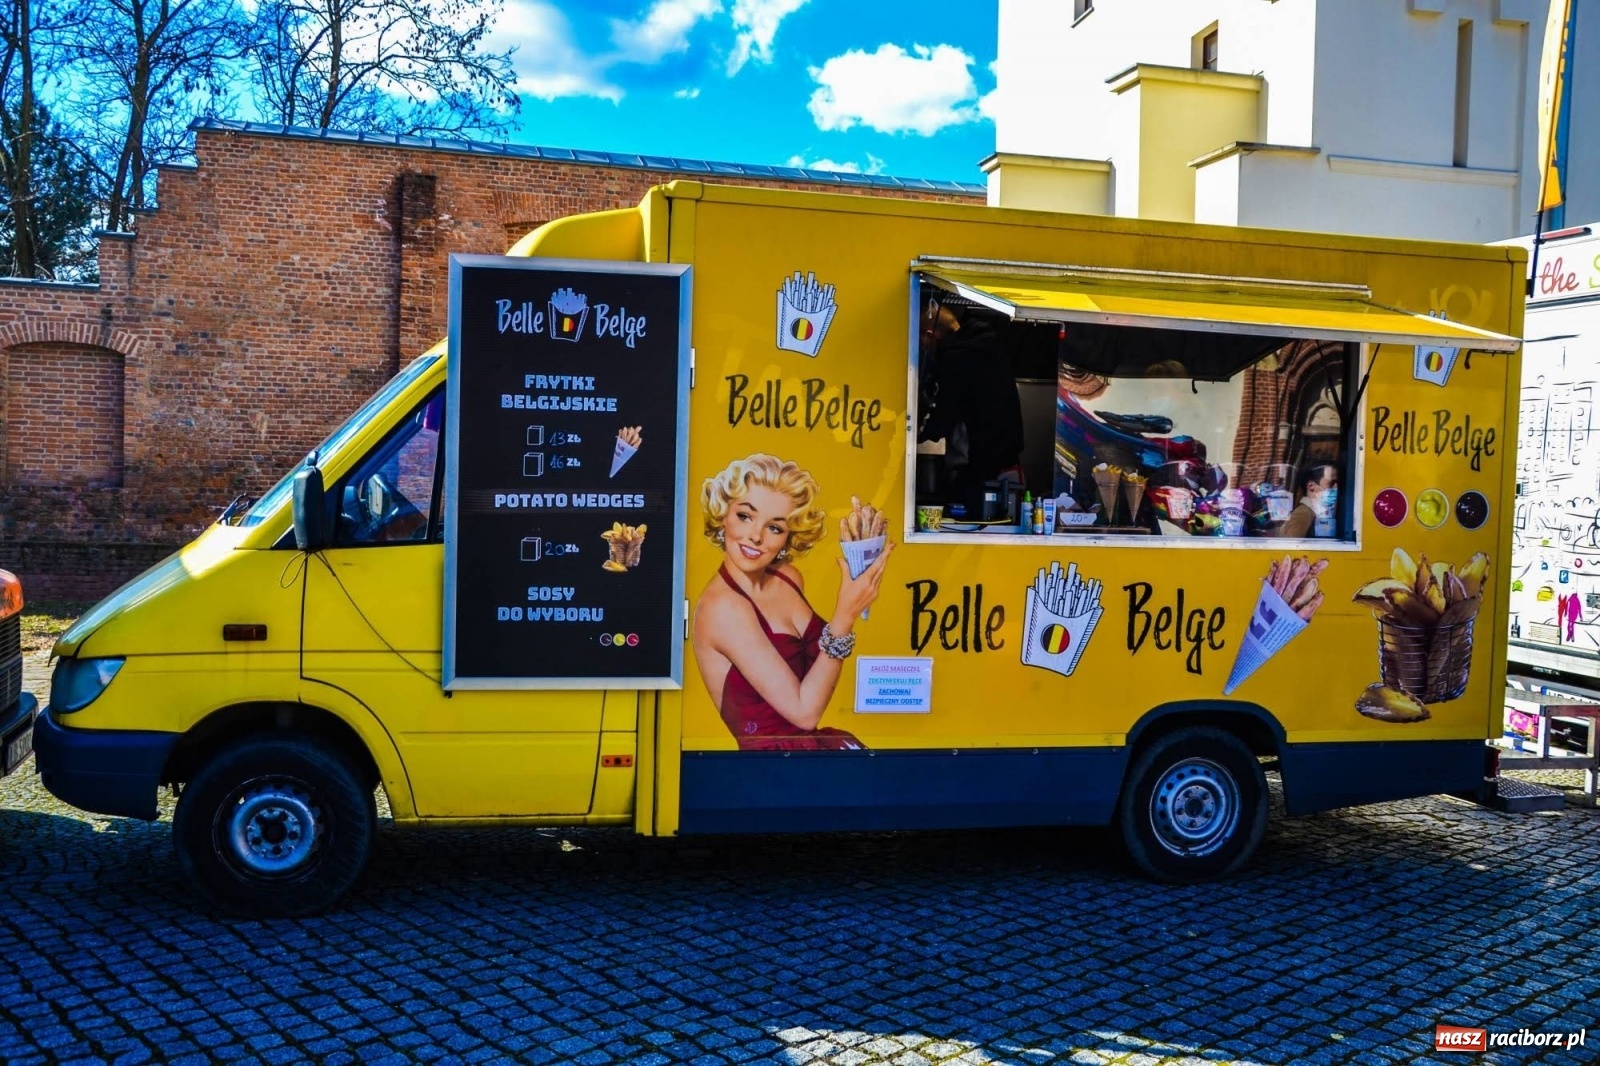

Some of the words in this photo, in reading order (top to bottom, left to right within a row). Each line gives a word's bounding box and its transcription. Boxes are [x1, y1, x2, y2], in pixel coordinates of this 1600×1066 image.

[1539, 256, 1580, 294] the
[496, 299, 544, 335] Belle
[593, 303, 647, 349] Belge
[525, 374, 595, 391] FRYTKI
[501, 394, 618, 412] BELGIJSKIE
[725, 374, 798, 429] Belle
[802, 378, 882, 449] Belge
[1371, 406, 1429, 455] Belle
[1432, 409, 1496, 472] Belge
[495, 493, 568, 508] POTATO
[572, 494, 645, 508] WEDGES
[527, 586, 575, 601] SOSY
[497, 607, 523, 621] DO
[527, 607, 604, 622] WYBORU
[905, 579, 1005, 656] Belle
[1123, 581, 1226, 675] Belge
[866, 698, 899, 706] BEZPIECZNY
